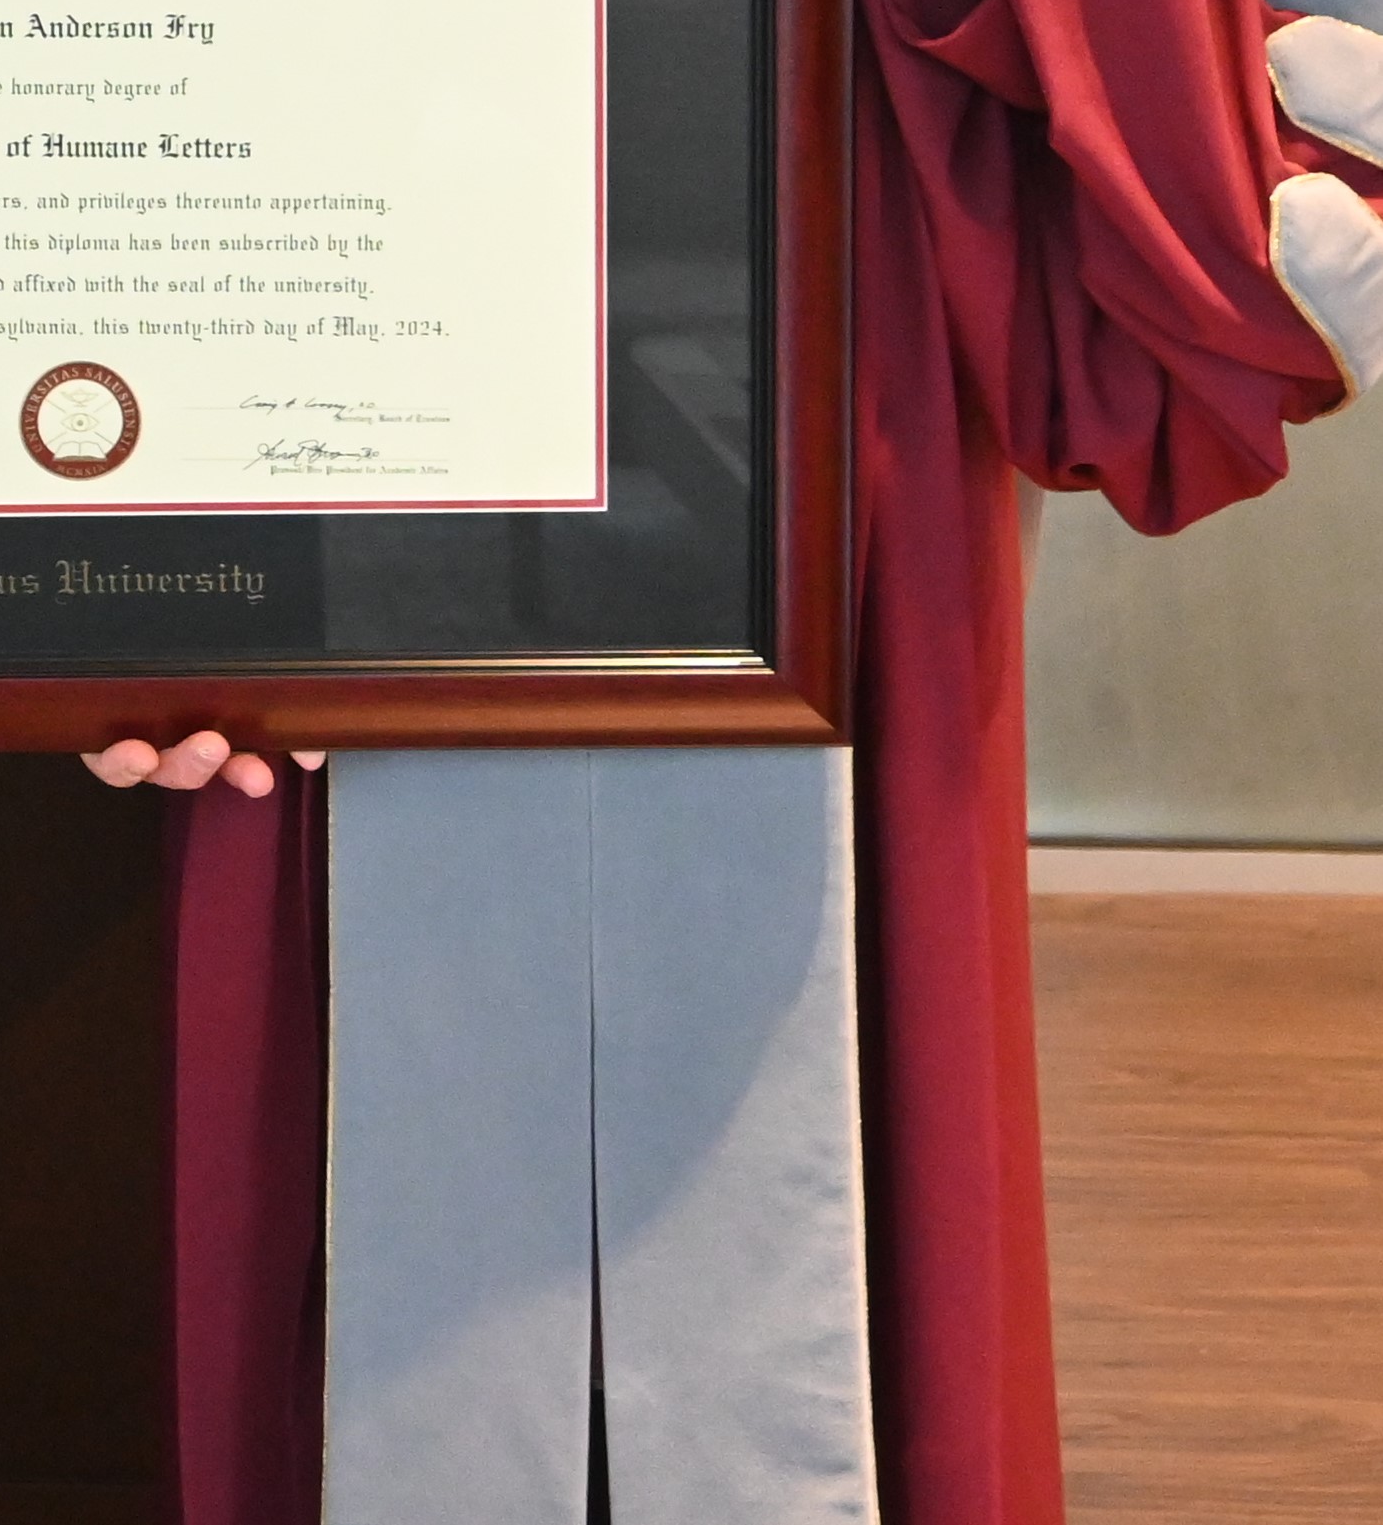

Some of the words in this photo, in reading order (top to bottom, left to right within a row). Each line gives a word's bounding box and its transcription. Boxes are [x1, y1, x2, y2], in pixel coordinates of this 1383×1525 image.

[23, 13, 153, 40] Anderson
[162, 13, 215, 46] Fry
[11, 77, 96, 104] honorary
[103, 78, 161, 102] degree
[169, 76, 189, 96] of
[5, 133, 34, 159] of
[40, 132, 148, 159] Humane
[157, 133, 252, 159] Letters
[36, 192, 70, 210] and
[77, 191, 167, 216] privileges
[176, 191, 262, 210] thereunto
[269, 193, 392, 217] appertaining.
[4, 232, 40, 251] this
[48, 233, 121, 256] diploma
[128, 232, 163, 252] has
[170, 232, 211, 252] been
[218, 233, 319, 252] subscribed
[327, 233, 349, 259] by
[357, 233, 384, 252] the
[12, 273, 76, 293] affixed
[84, 274, 125, 293] with
[132, 274, 160, 293] the
[167, 275, 205, 293] seal
[213, 273, 233, 293] of
[239, 275, 266, 293] the
[274, 276, 375, 301] university.
[93, 316, 130, 335] this
[138, 317, 255, 343] twenty-third
[264, 319, 298, 343] day
[306, 316, 326, 336] of
[395, 320, 450, 337] 2024.
[25, 368, 79, 453] UNIVERSITAS
[55, 559, 266, 605] University
